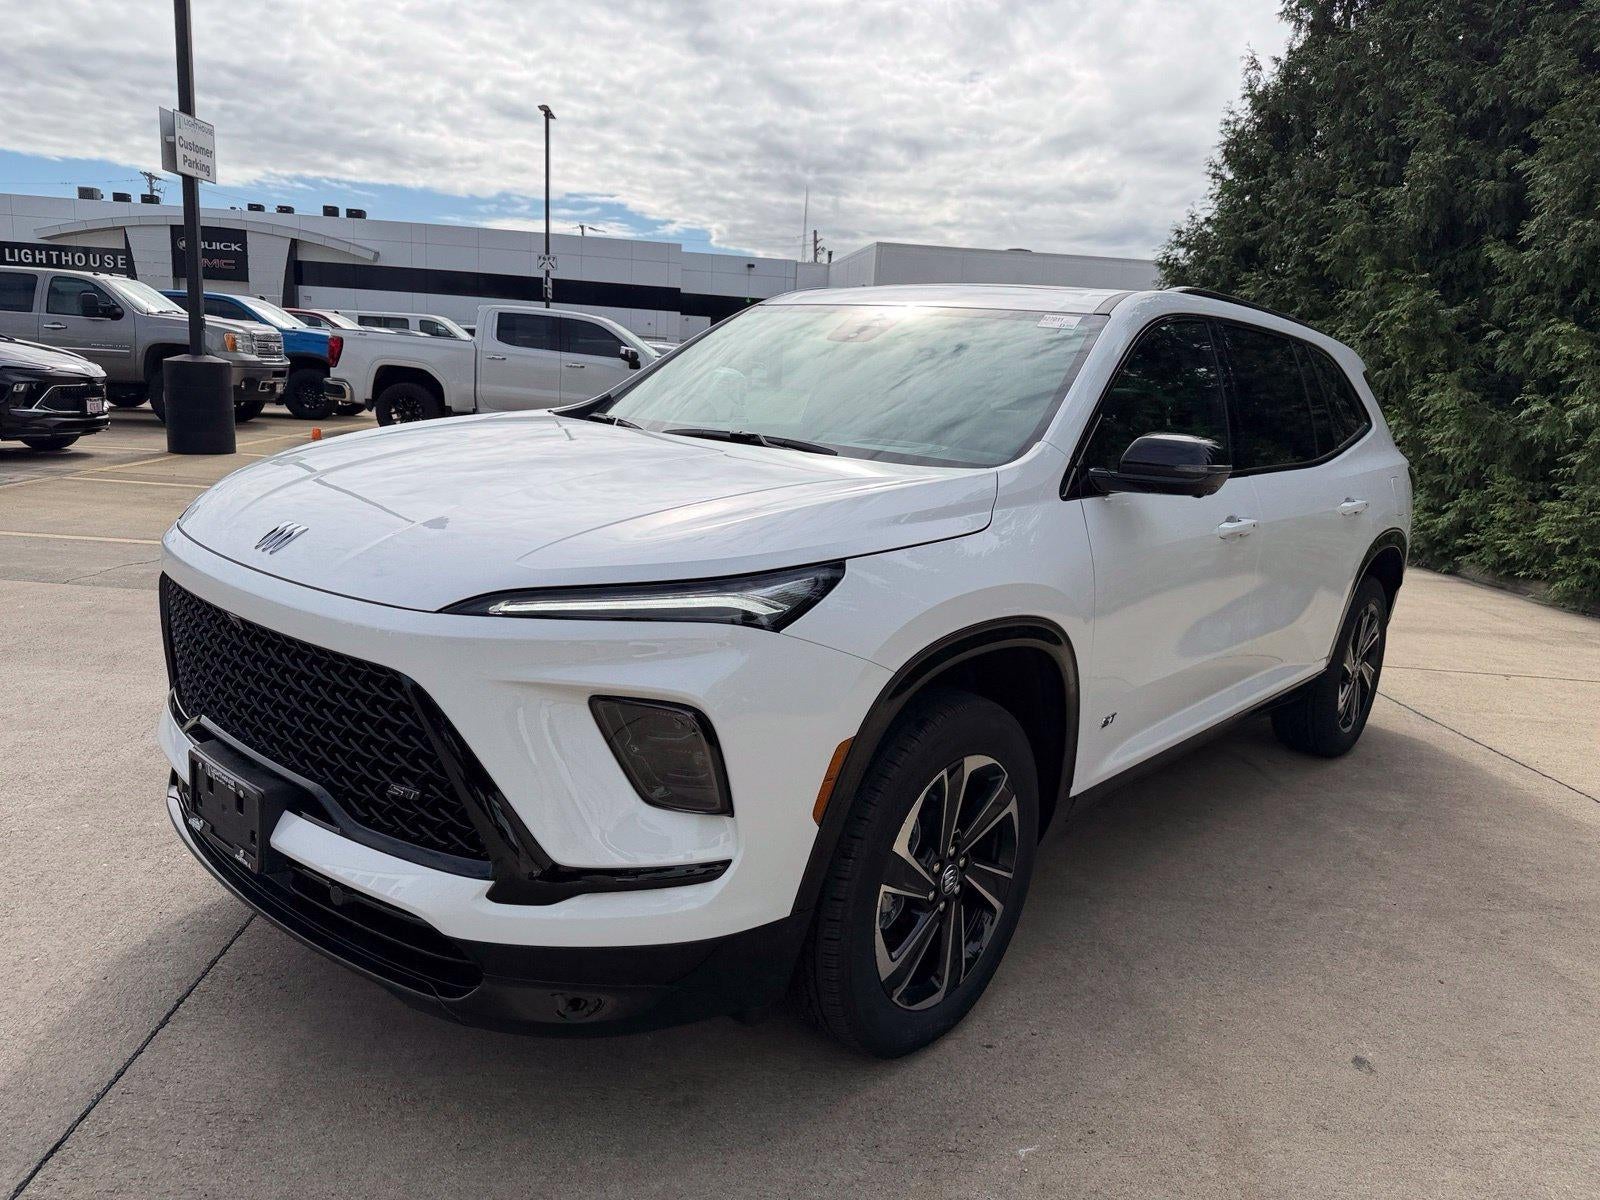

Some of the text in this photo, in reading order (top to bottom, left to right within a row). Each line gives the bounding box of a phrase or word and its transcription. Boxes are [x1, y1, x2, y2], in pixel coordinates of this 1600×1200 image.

[178, 135, 213, 159] Customer
[182, 153, 211, 177] Parking
[5, 247, 127, 269] LIGHTHOUSE
[201, 257, 236, 270] MC
